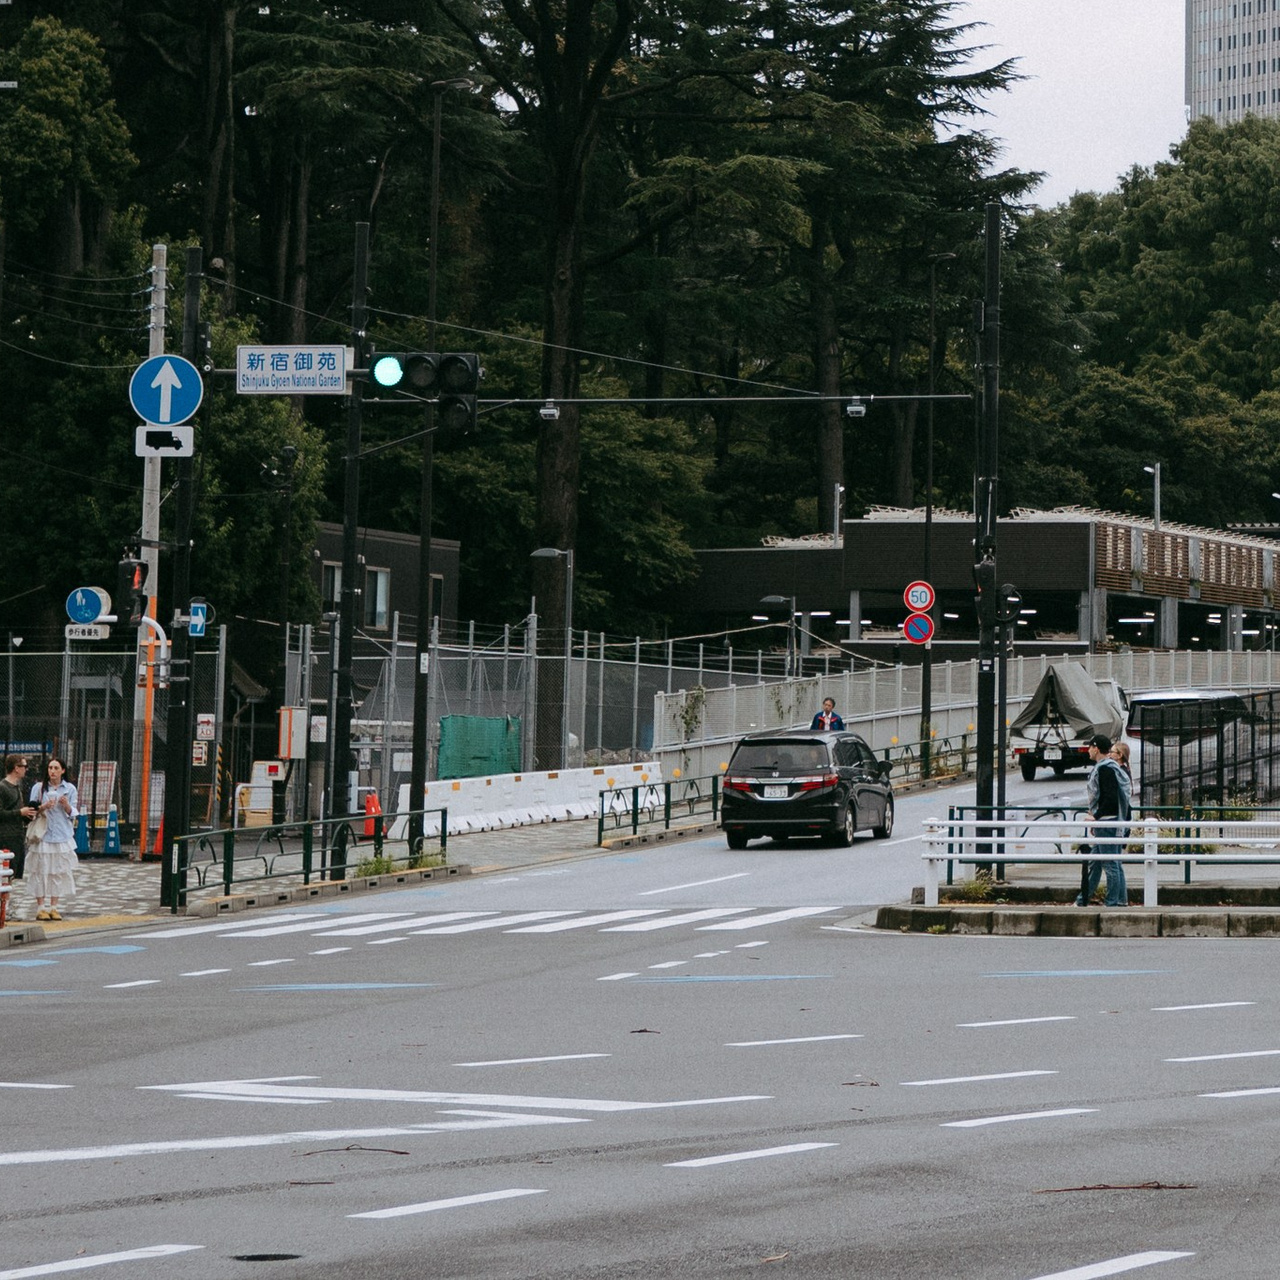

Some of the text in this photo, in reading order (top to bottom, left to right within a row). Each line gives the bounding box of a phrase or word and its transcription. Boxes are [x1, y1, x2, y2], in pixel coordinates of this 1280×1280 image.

[246, 352, 337, 371] 新宿御苑
[242, 373, 341, 389] Shinjuku Gyoen National Garden
[911, 590, 928, 604] 50
[68, 628, 99, 637] 歩行者優先
